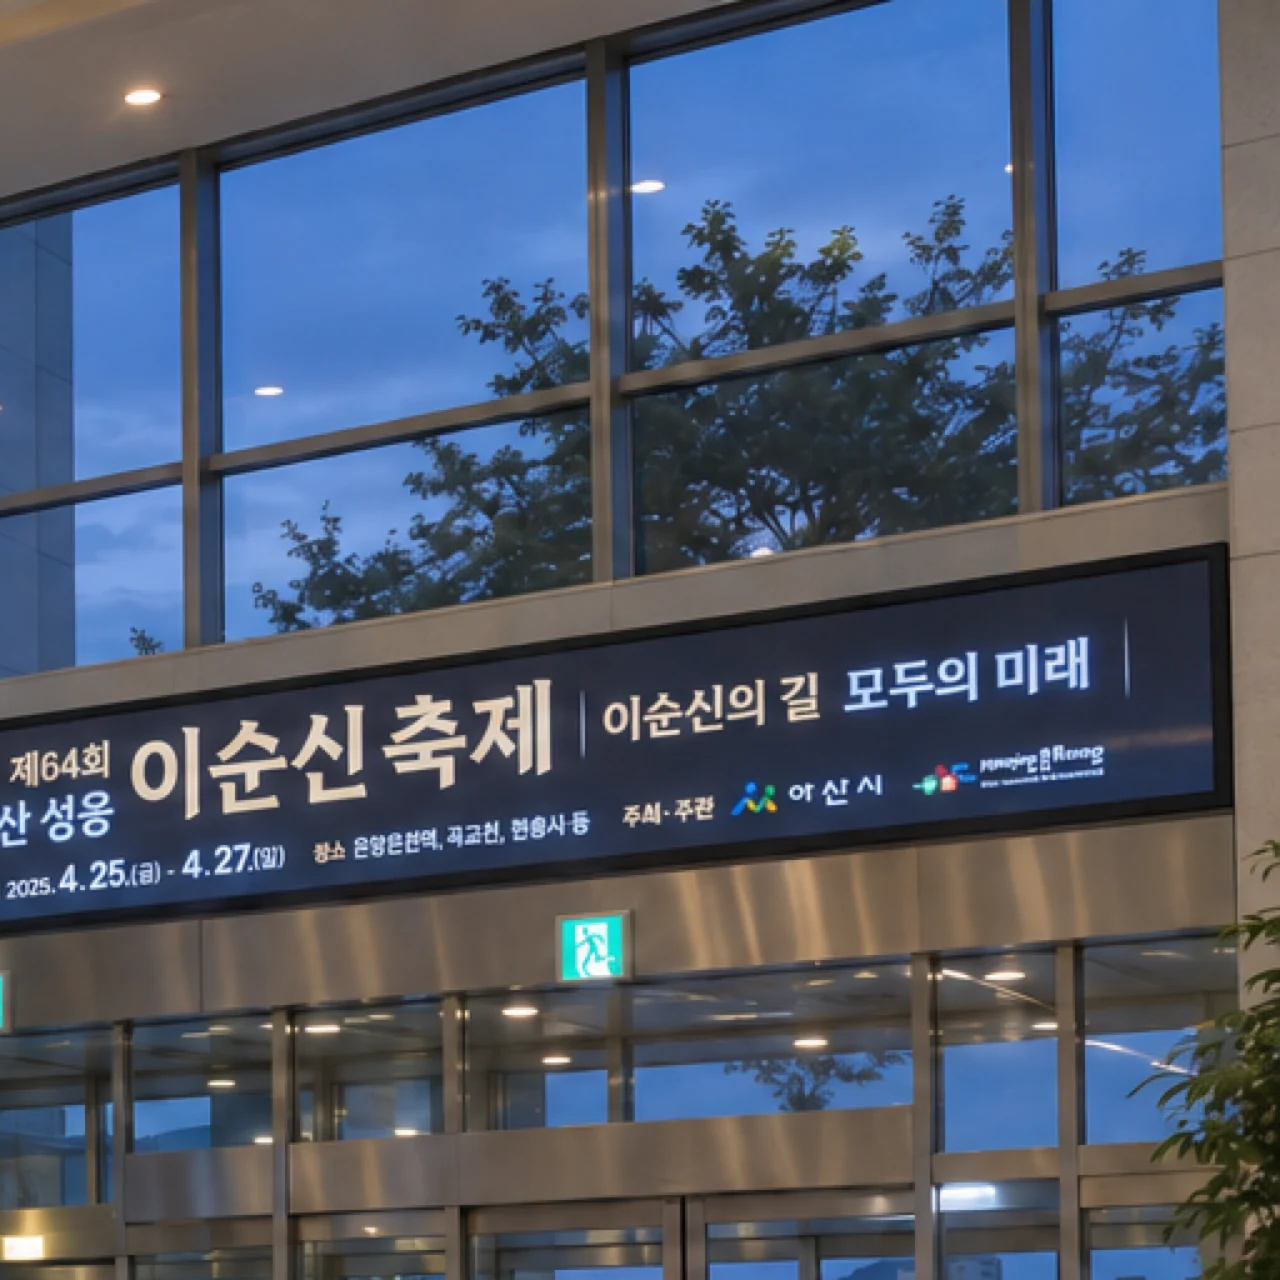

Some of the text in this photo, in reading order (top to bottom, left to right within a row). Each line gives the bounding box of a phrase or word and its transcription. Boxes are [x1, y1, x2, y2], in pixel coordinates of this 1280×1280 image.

[603, 636, 1091, 741] 이순신의 길 모두의 미래
[9, 739, 111, 787] 제64회
[131, 678, 554, 821] 이순신 축제
